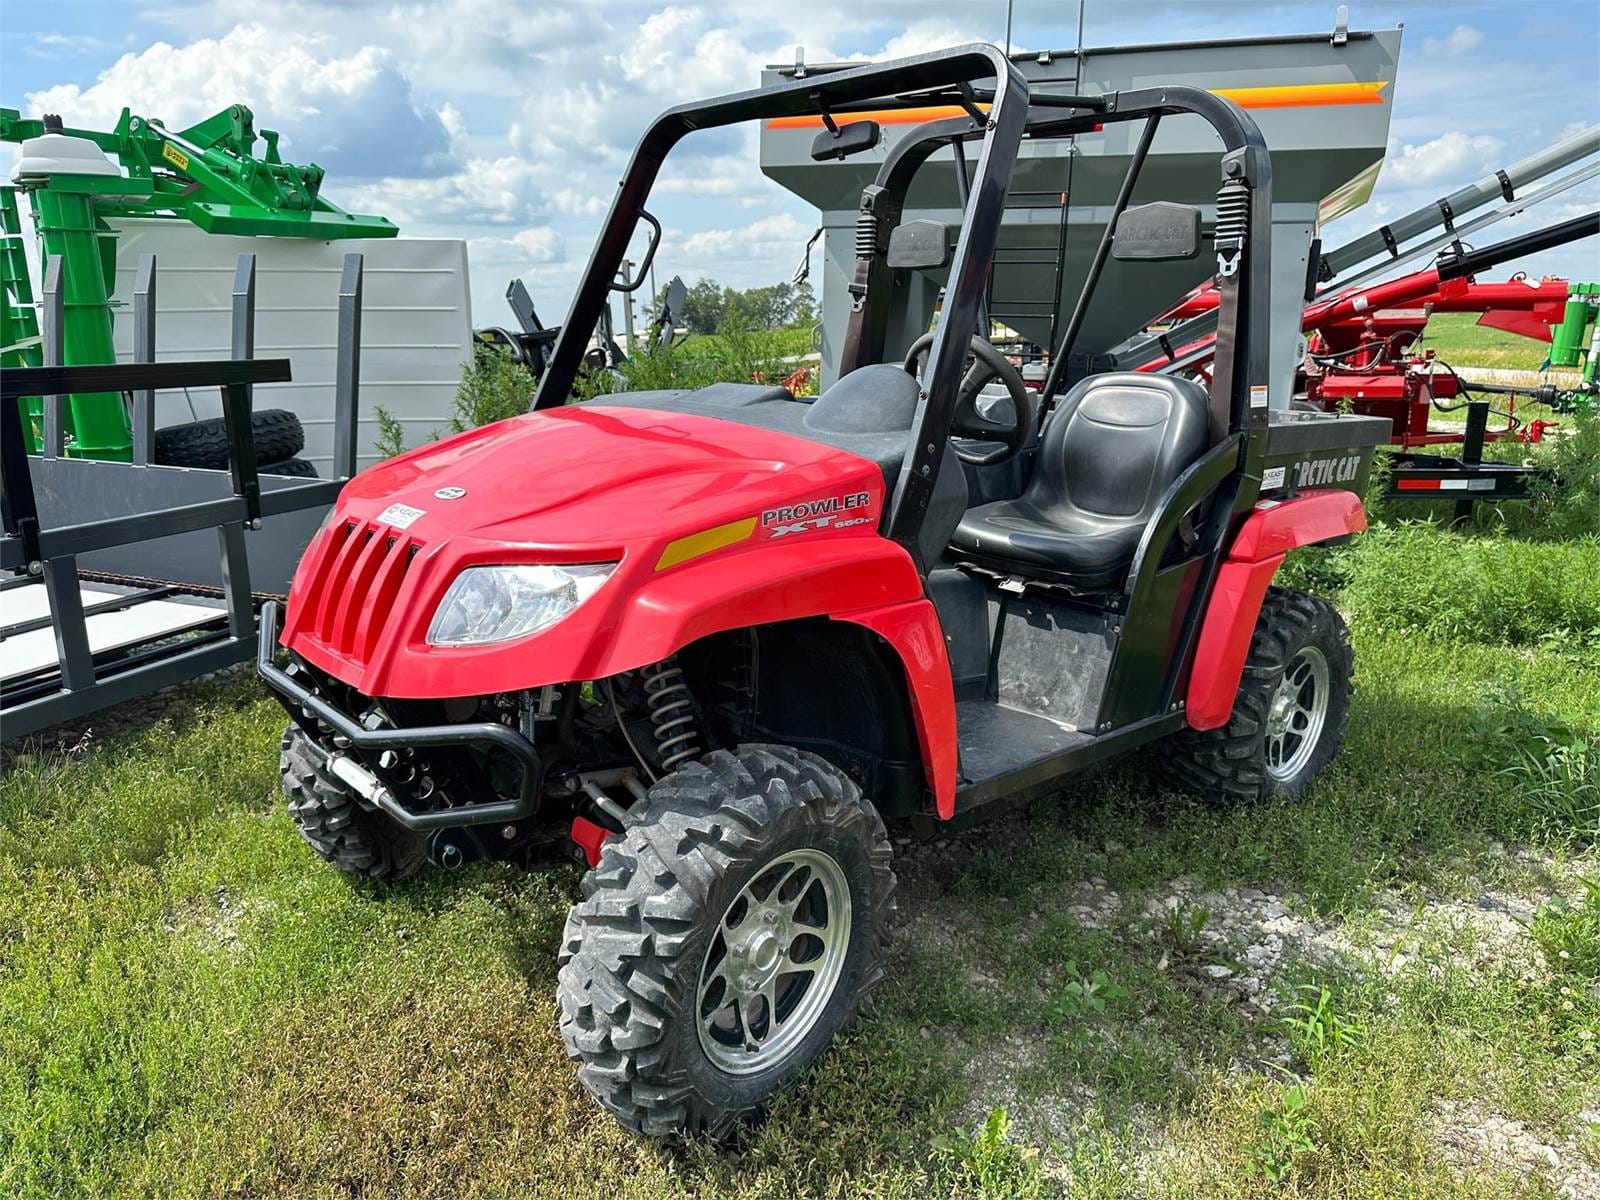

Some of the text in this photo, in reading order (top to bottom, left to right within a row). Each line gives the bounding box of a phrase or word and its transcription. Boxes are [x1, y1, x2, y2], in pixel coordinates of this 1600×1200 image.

[1336, 455, 1361, 482] CAT
[762, 492, 870, 526] PROWLER
[769, 515, 838, 538] XT
